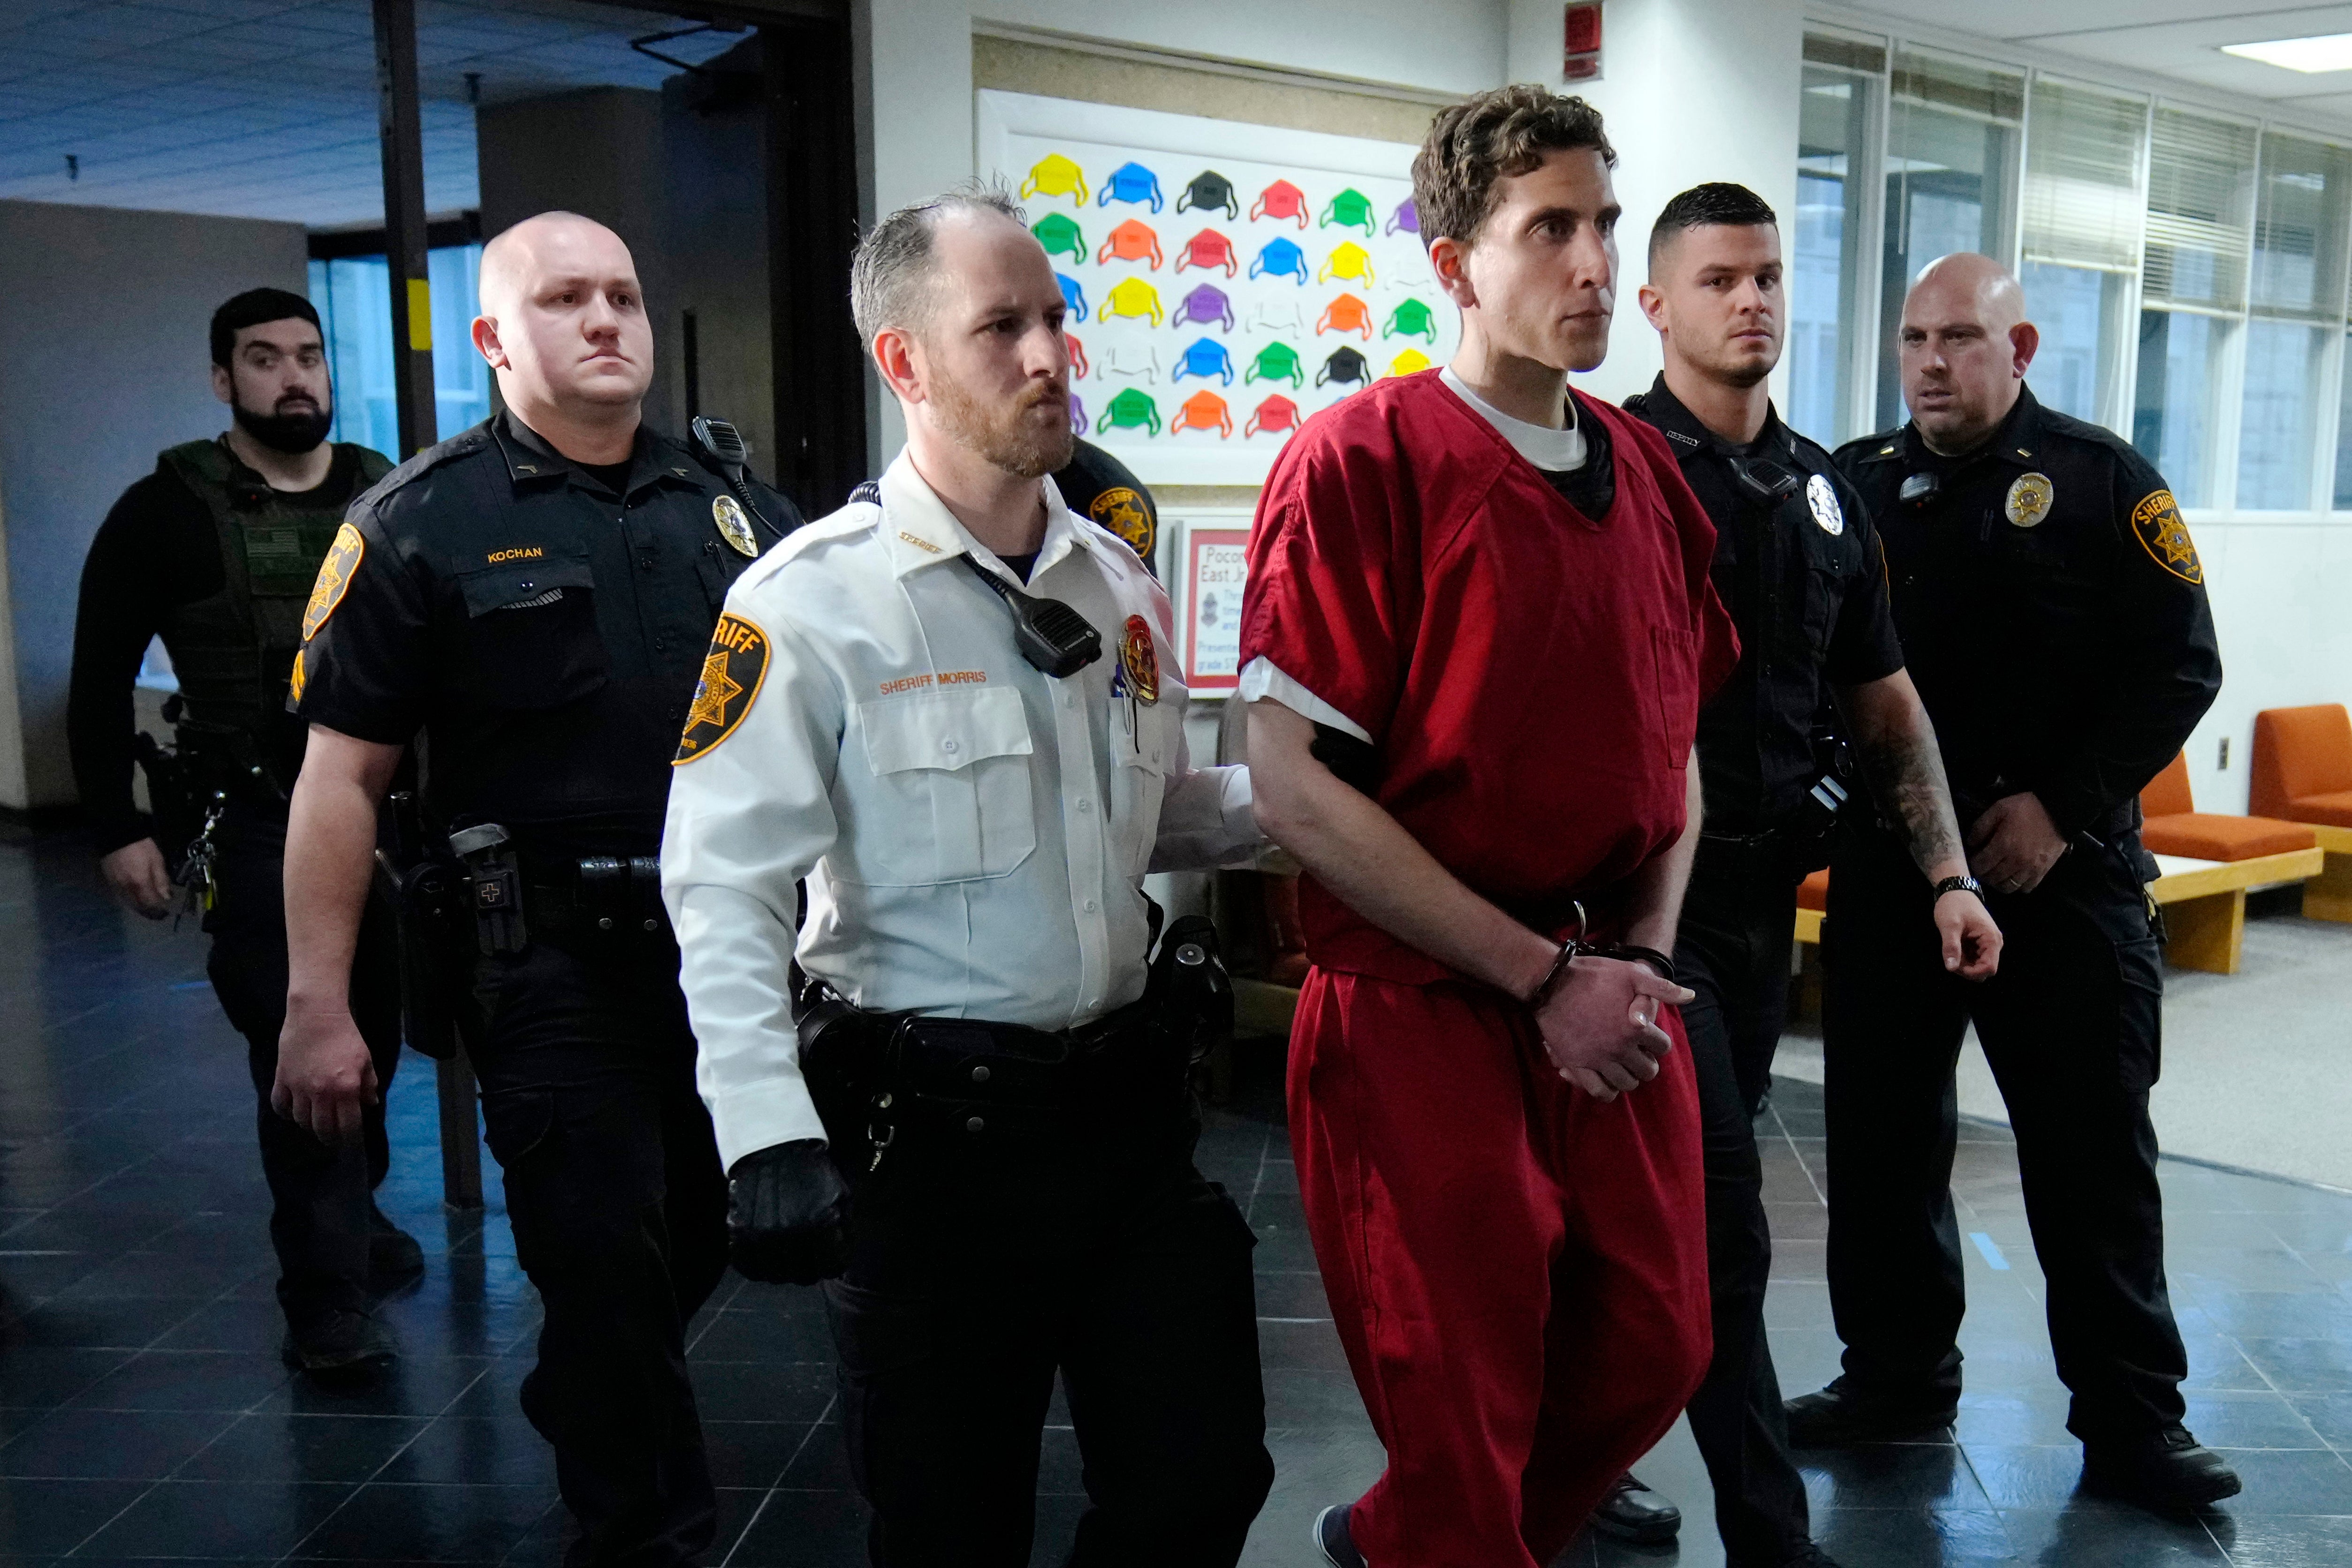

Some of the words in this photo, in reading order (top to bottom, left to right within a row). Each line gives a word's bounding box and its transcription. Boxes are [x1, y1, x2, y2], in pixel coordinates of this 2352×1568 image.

[488, 547, 542, 563] KOCHAN
[1200, 565, 1229, 582] East
[880, 674, 933, 695] SHERIFF
[938, 671, 987, 685] MORRIS
